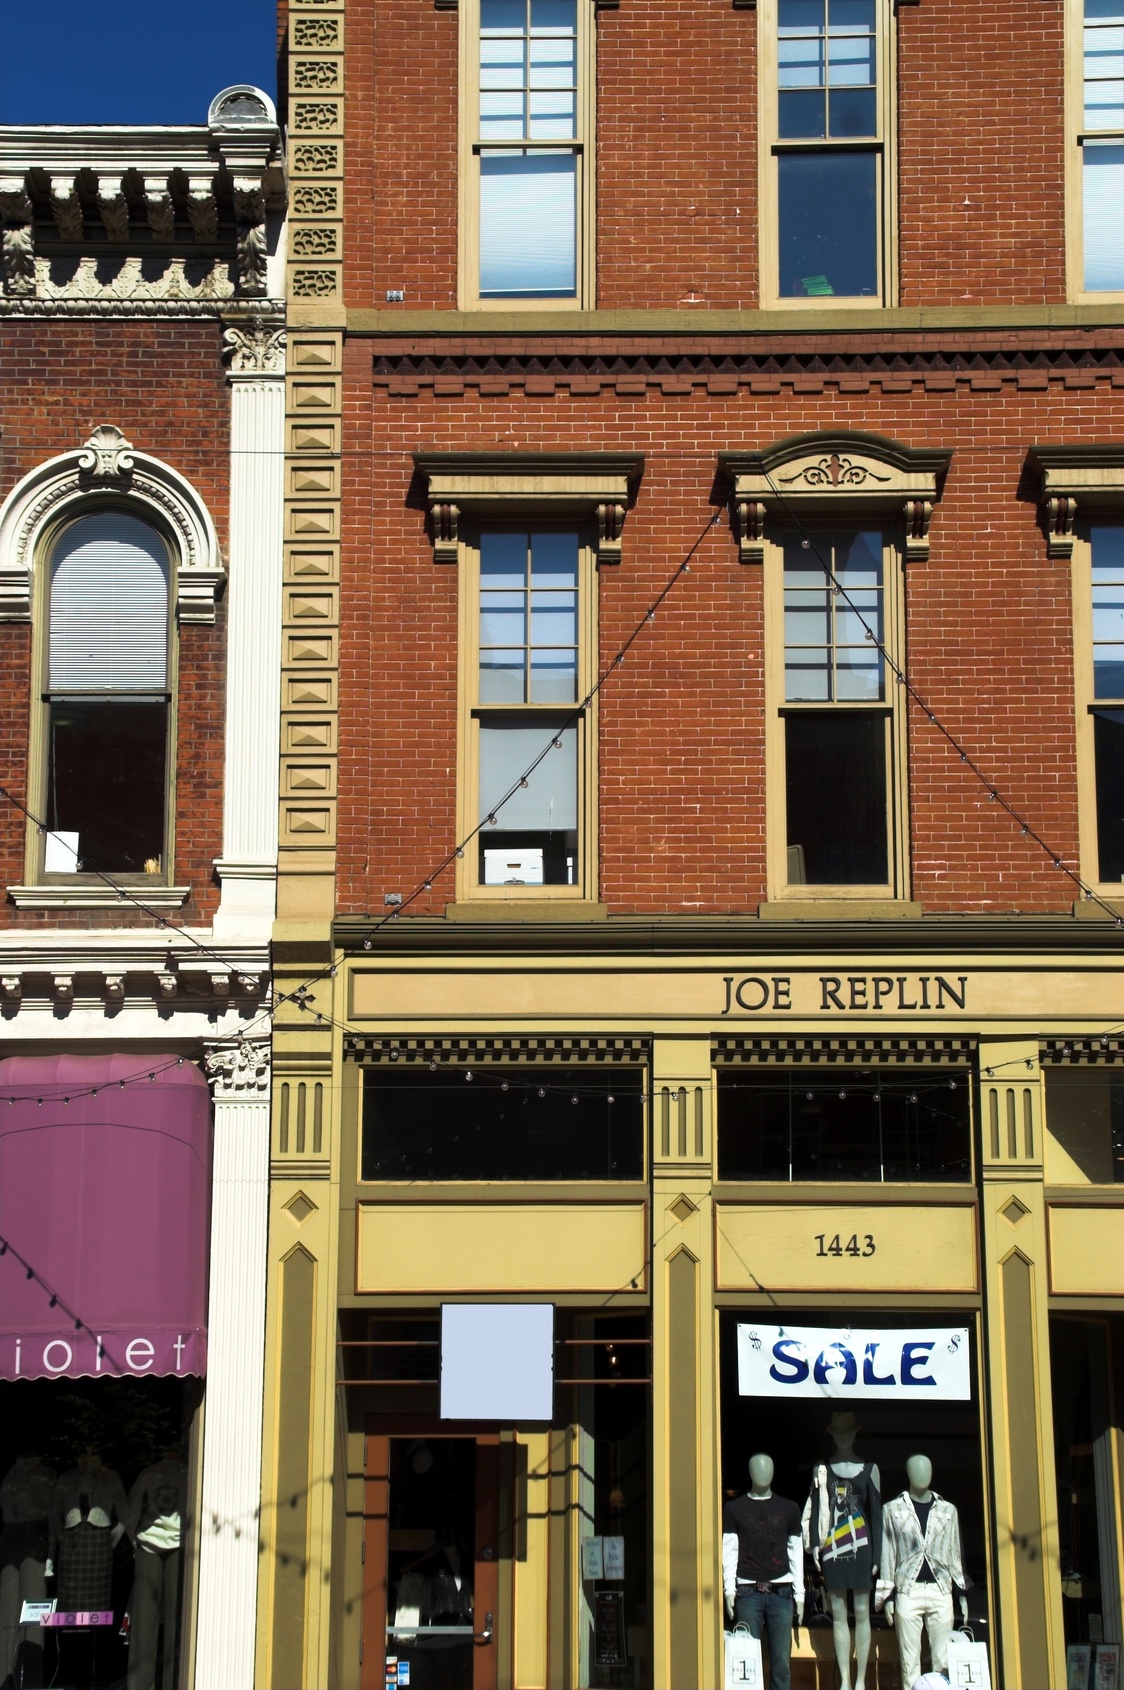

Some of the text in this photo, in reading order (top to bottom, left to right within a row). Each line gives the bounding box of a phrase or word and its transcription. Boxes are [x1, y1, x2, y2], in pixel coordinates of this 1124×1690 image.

[721, 976, 968, 1015] JOE REPLIN
[814, 1234, 876, 1257] 1443
[769, 1339, 937, 1385] SALE
[42, 1612, 110, 1624] violet
[739, 1660, 750, 1680] 1
[963, 1663, 976, 1683] 1
